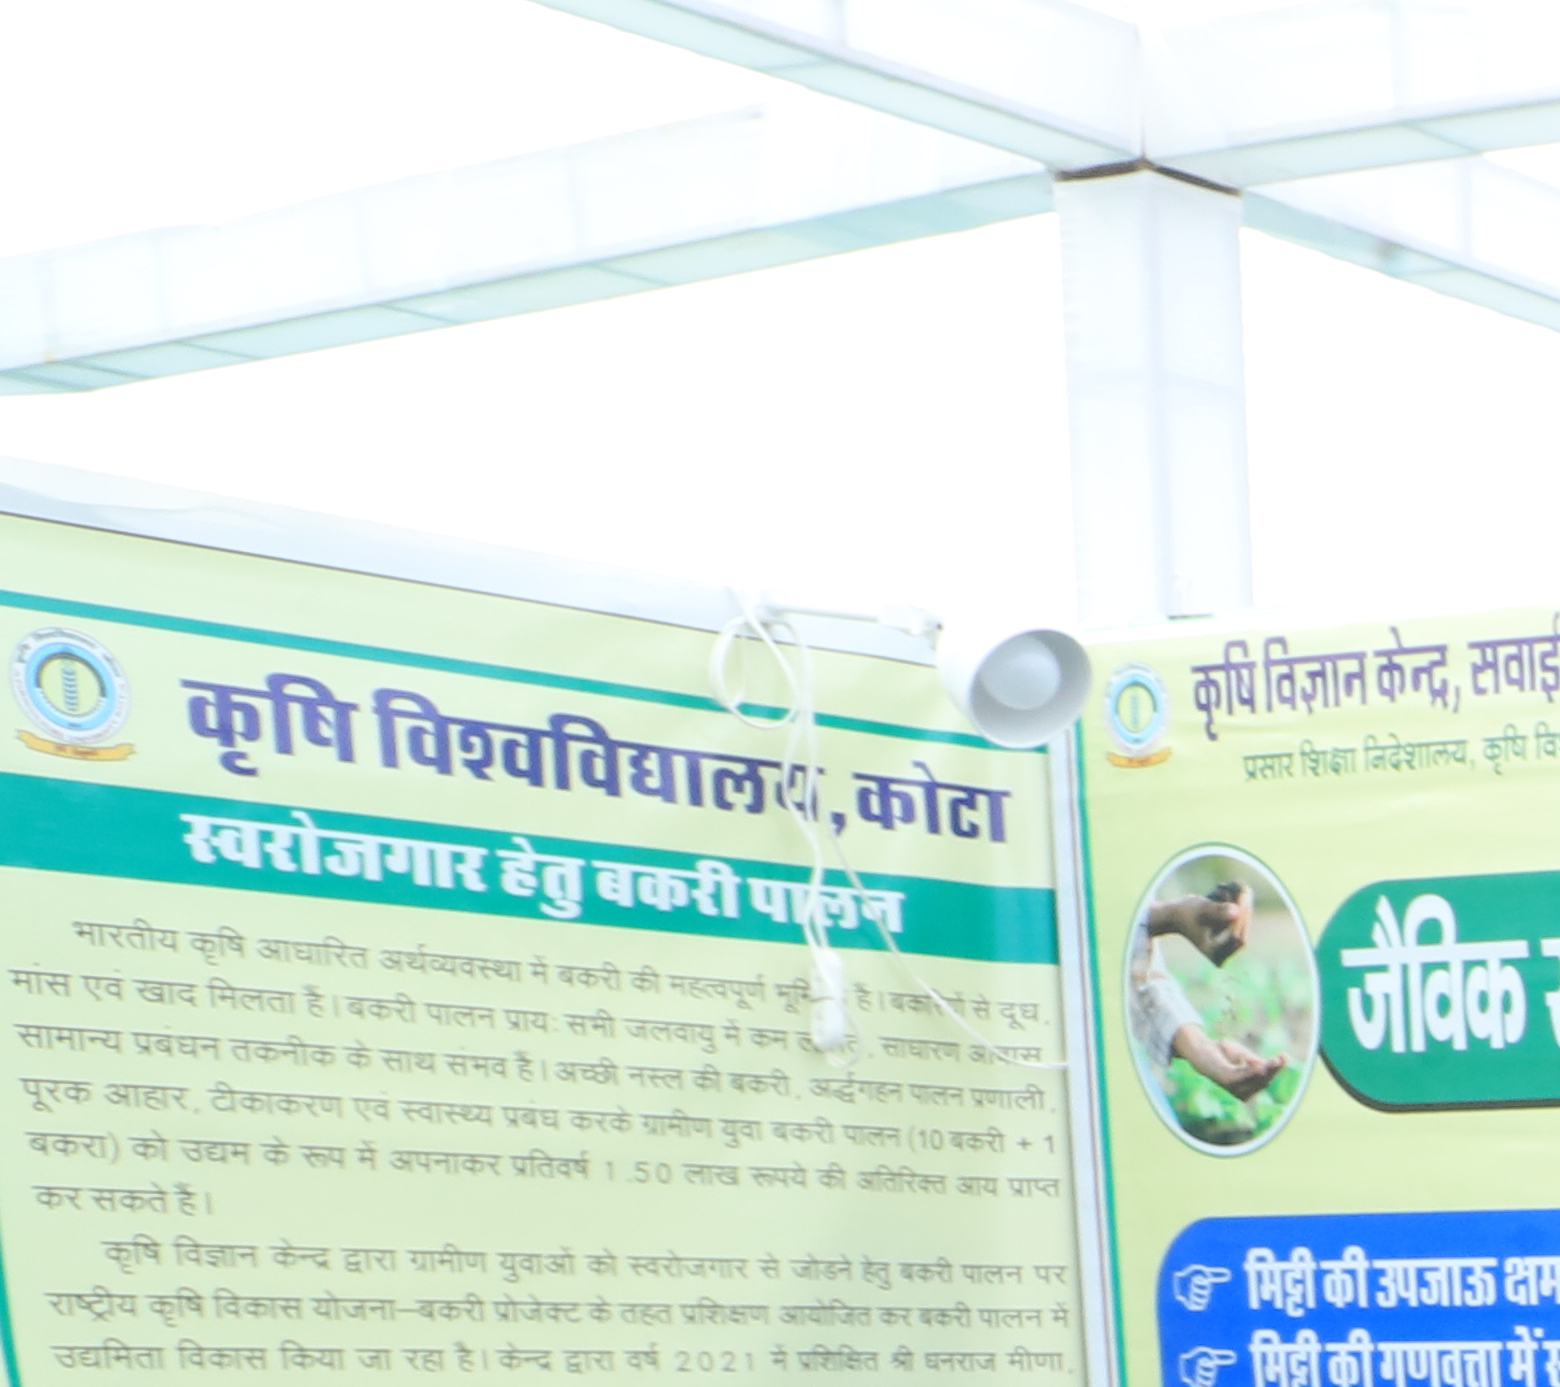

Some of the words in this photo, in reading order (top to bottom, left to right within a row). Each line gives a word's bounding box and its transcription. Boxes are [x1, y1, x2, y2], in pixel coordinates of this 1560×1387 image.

[1190, 641, 1257, 741] कृषि
[1263, 638, 1367, 715] विज्ञान
[1373, 629, 1460, 714] केन्द्र,
[179, 813, 489, 892] स्वरोजगार
[495, 842, 593, 915] हेतु
[592, 859, 742, 918] बकरी
[1338, 888, 1529, 1053] जैविक
[1242, 1246, 1319, 1318] मिट्टी
[1318, 1244, 1372, 1309] की
[1371, 1256, 1499, 1308] उपजाऊ
